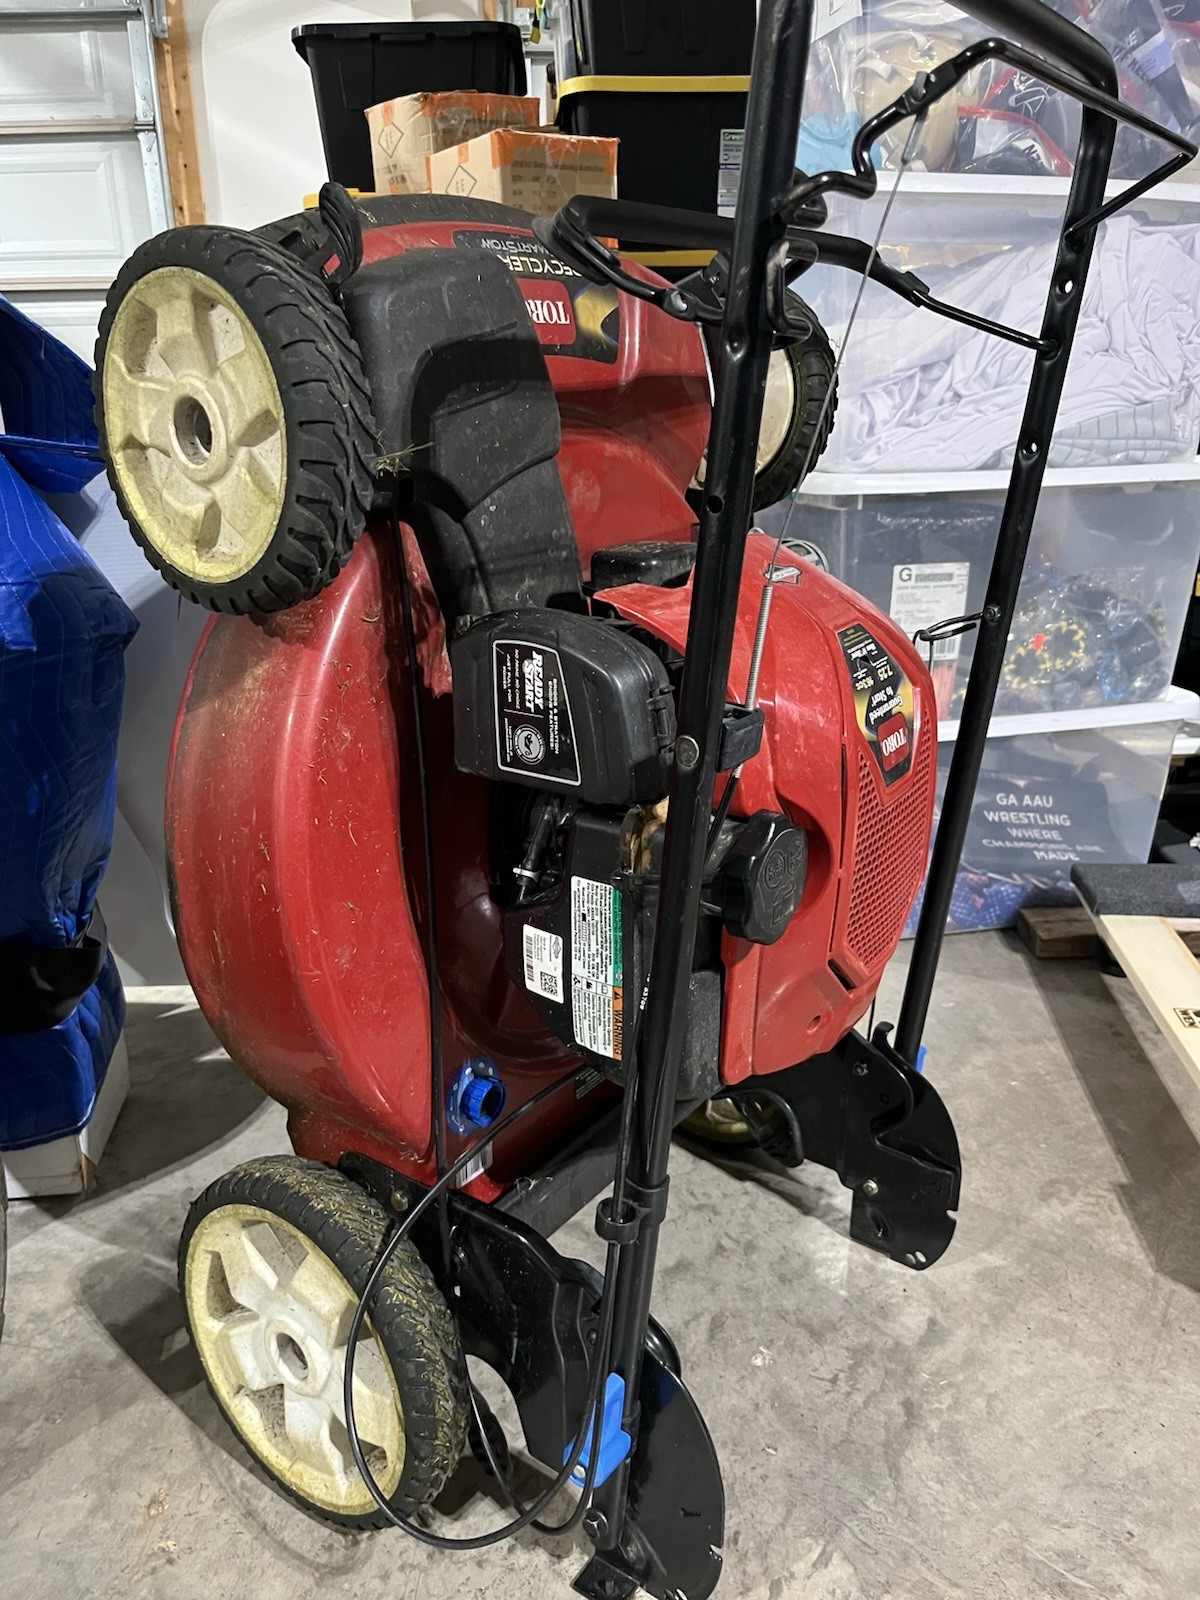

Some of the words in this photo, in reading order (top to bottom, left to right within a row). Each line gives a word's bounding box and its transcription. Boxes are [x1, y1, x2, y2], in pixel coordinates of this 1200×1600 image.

[481, 238, 555, 258] MARTSTOW
[496, 254, 582, 277] ECYCLER
[524, 299, 570, 325] TOR
[899, 567, 912, 582] G
[532, 650, 544, 710] READY
[877, 663, 894, 681] 7.25
[523, 660, 535, 713] START
[869, 694, 903, 725] Guaranteed
[881, 727, 907, 757] TORO
[996, 792, 1018, 807] GA
[1022, 794, 1053, 807] AAU
[983, 810, 1072, 827] WRESTLING
[1006, 827, 1064, 841] WHERE
[1032, 850, 1080, 861] MADE
[614, 1010, 623, 1055] WARNING
